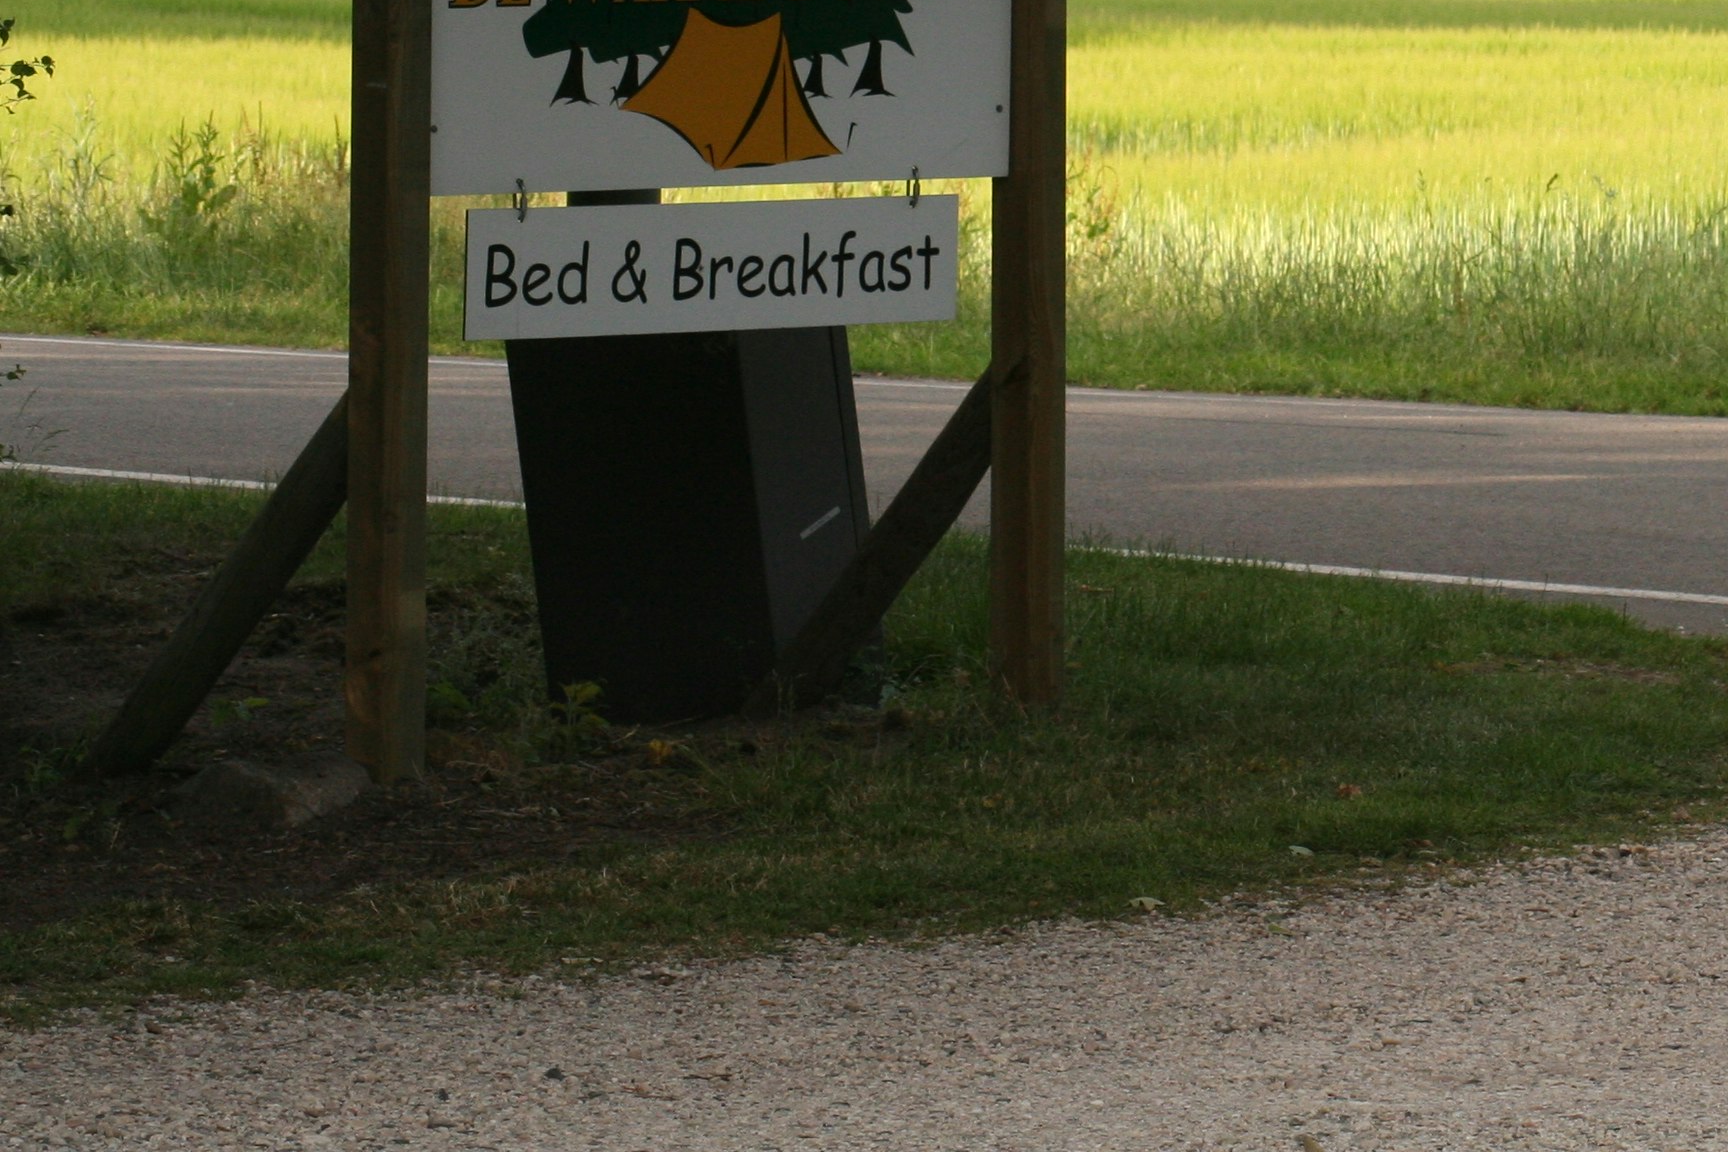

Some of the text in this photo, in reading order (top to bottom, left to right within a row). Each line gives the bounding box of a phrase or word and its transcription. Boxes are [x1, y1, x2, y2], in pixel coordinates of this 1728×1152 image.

[484, 230, 940, 308] Bed & Breakfast
